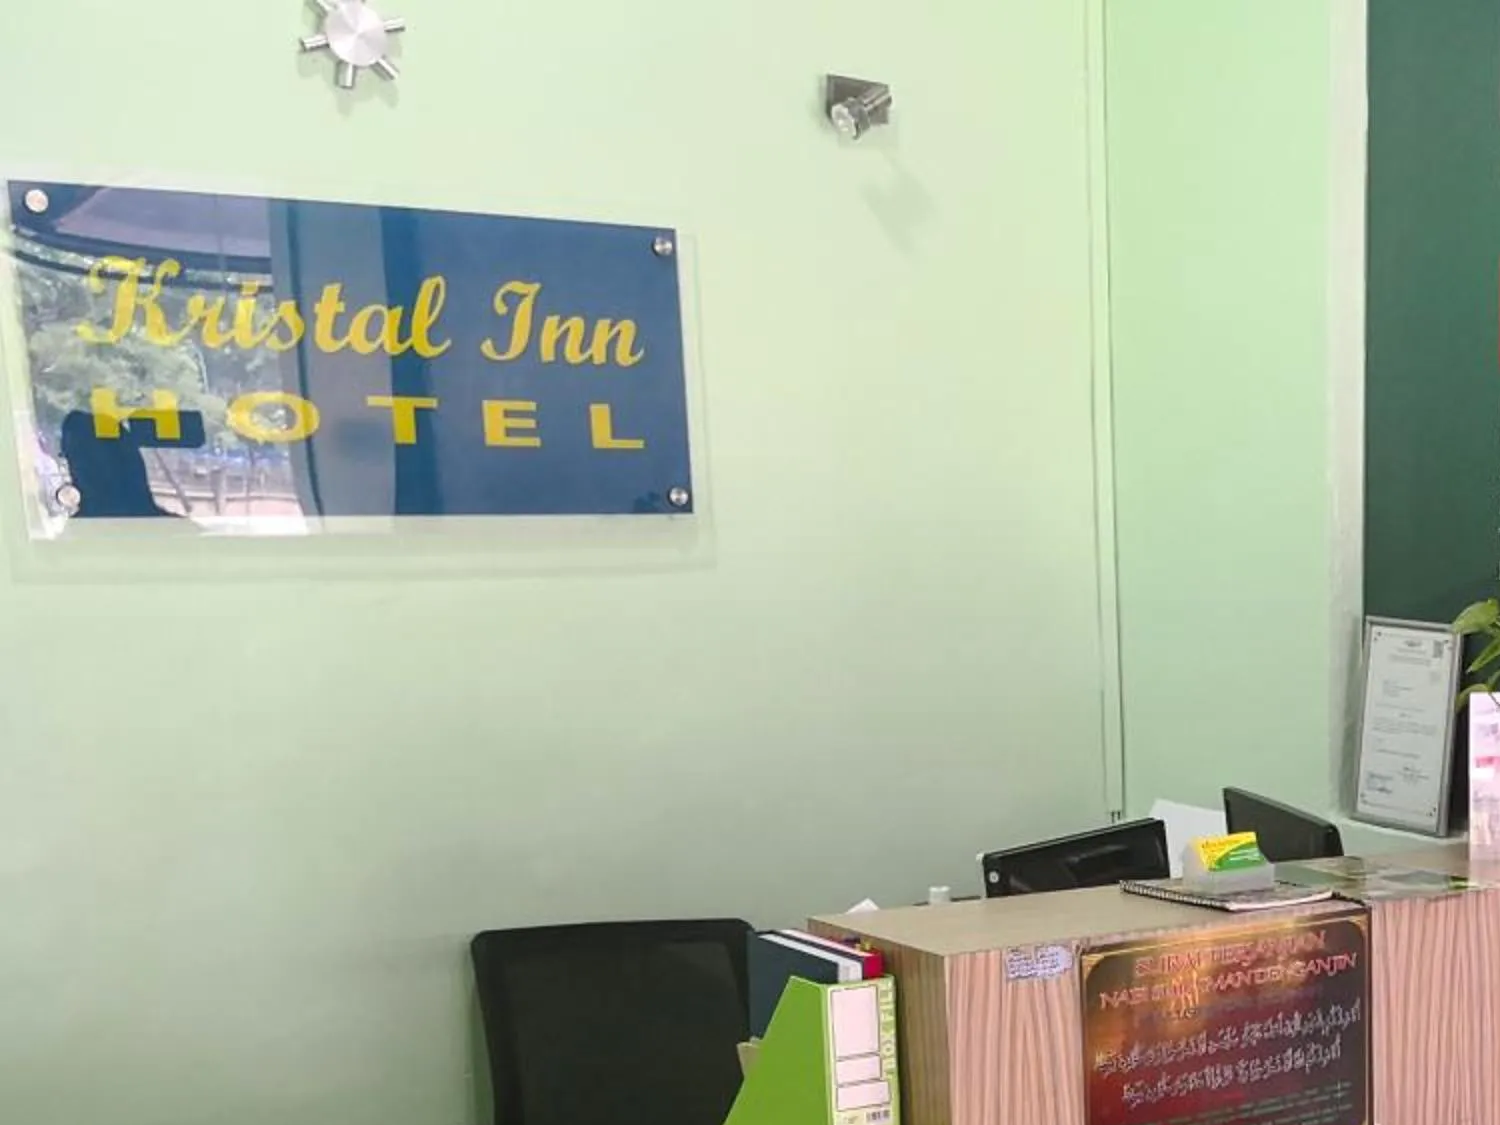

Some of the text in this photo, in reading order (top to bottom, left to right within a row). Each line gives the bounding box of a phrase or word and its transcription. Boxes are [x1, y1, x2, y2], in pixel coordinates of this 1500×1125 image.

[76, 255, 645, 368] Kristal Inn
[92, 387, 645, 450] HOTEL
